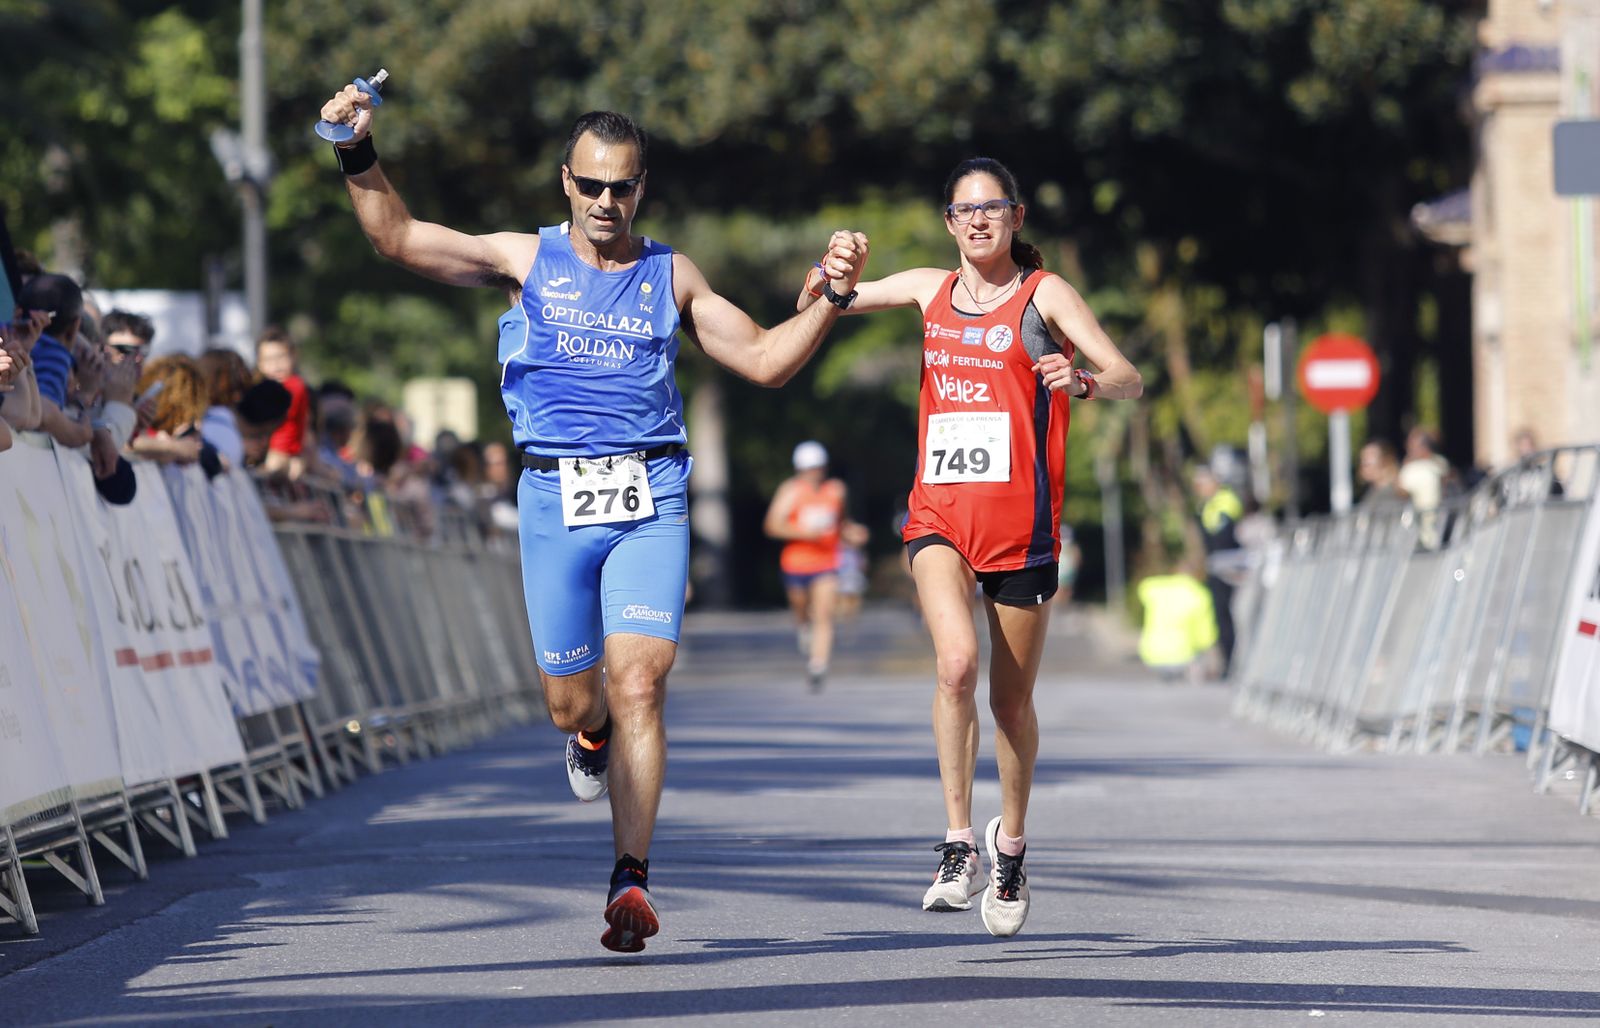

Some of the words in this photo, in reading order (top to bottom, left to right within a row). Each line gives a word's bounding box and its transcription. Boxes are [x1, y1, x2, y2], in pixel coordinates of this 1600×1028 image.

[639, 303, 653, 314] TAC
[952, 355, 1004, 370] FERTILIDAD
[933, 371, 991, 403] Vélez
[932, 447, 991, 476] 749
[573, 486, 640, 517] 276
[544, 650, 562, 661] PEPE
[565, 644, 590, 659] TAPIA
